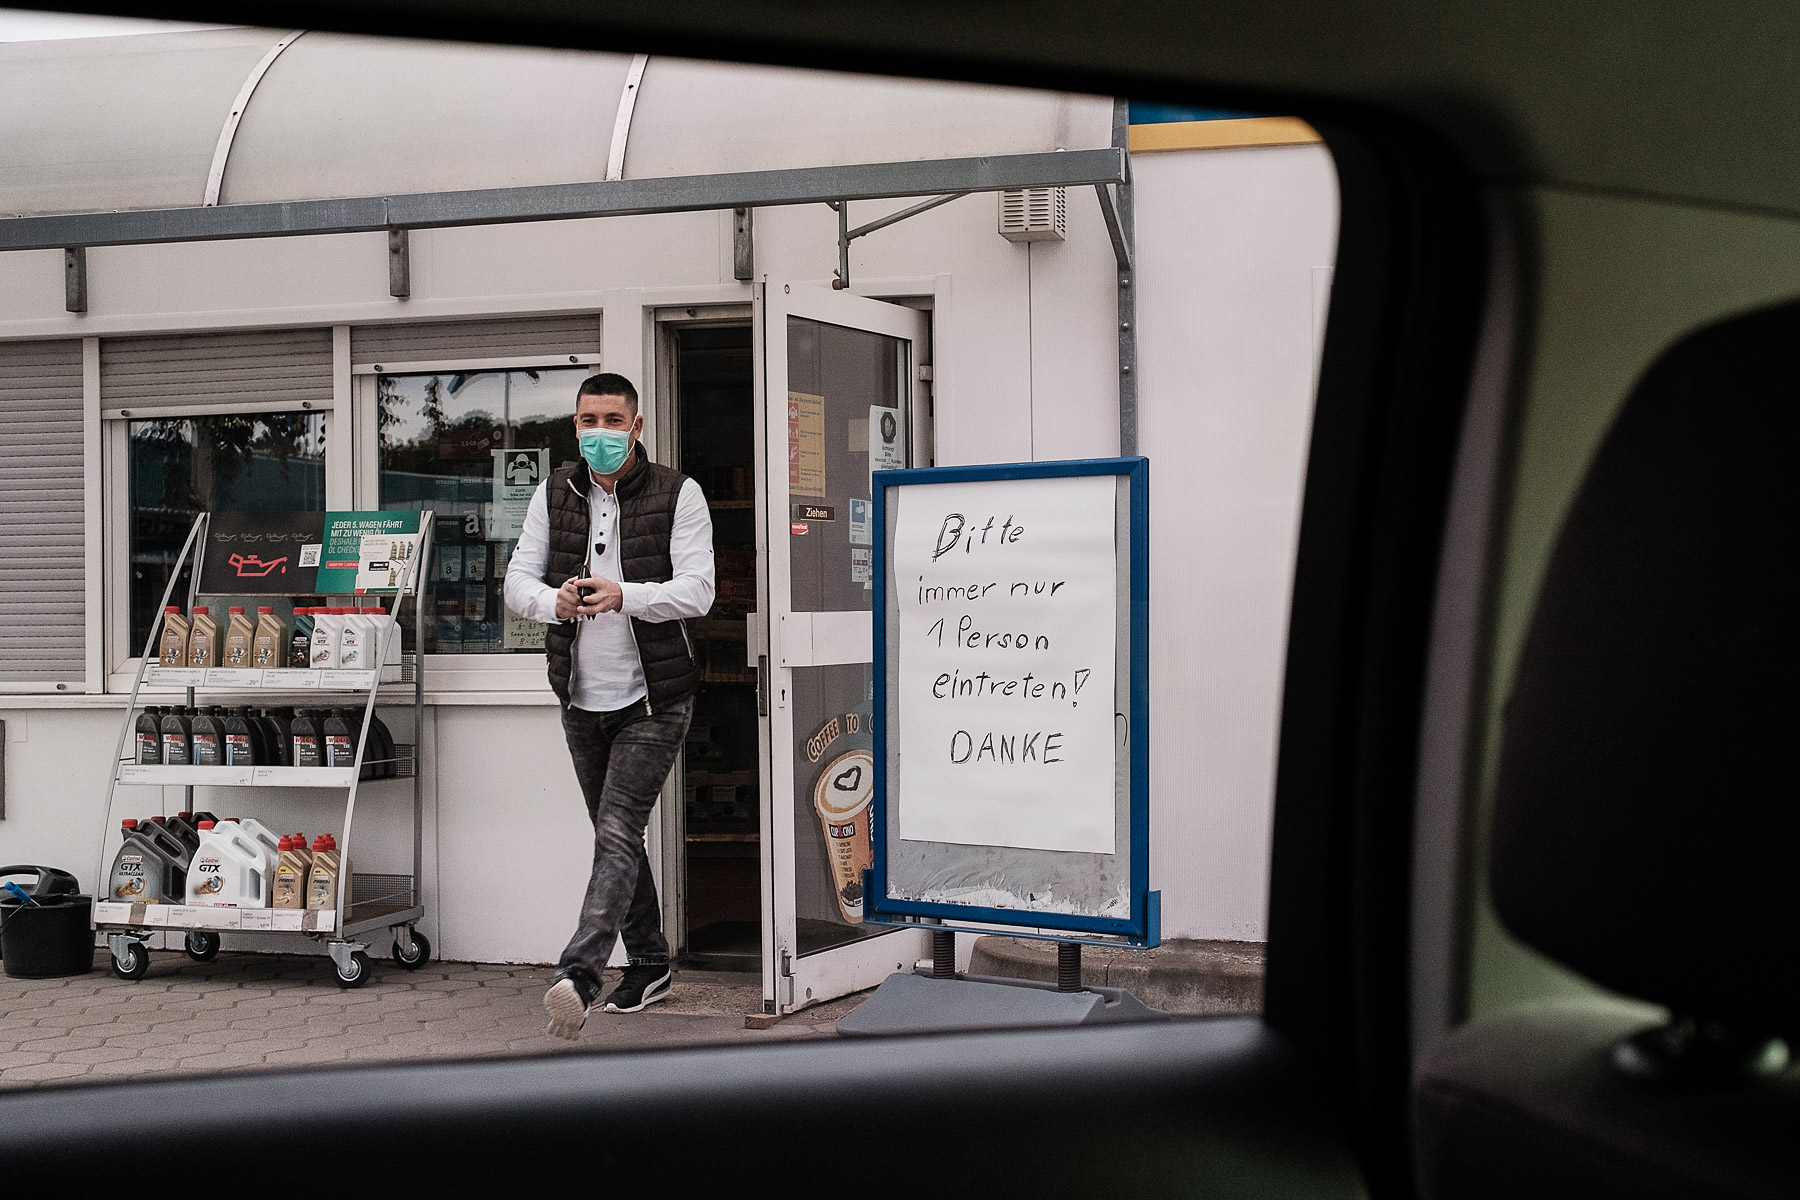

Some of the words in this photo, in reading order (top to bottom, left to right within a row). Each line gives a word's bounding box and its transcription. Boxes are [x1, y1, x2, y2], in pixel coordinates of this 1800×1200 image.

[332, 521, 350, 529] JEDER
[352, 521, 358, 529] 5.
[359, 521, 381, 529] WAGEN
[383, 520, 403, 528] FÄHRT
[805, 507, 828, 518] Ziehen
[329, 538, 357, 546] DESHALB
[932, 513, 1024, 563] Bitte
[918, 575, 997, 605] immer
[1010, 581, 1066, 598] nur
[927, 617, 944, 648] 1
[957, 614, 1050, 651] Person
[932, 668, 1091, 708] eintreten!
[807, 718, 839, 762] COFFEE
[846, 713, 859, 734] TO
[950, 730, 1064, 765] DANKE
[120, 863, 142, 871] GTX
[199, 865, 221, 873] GTX
